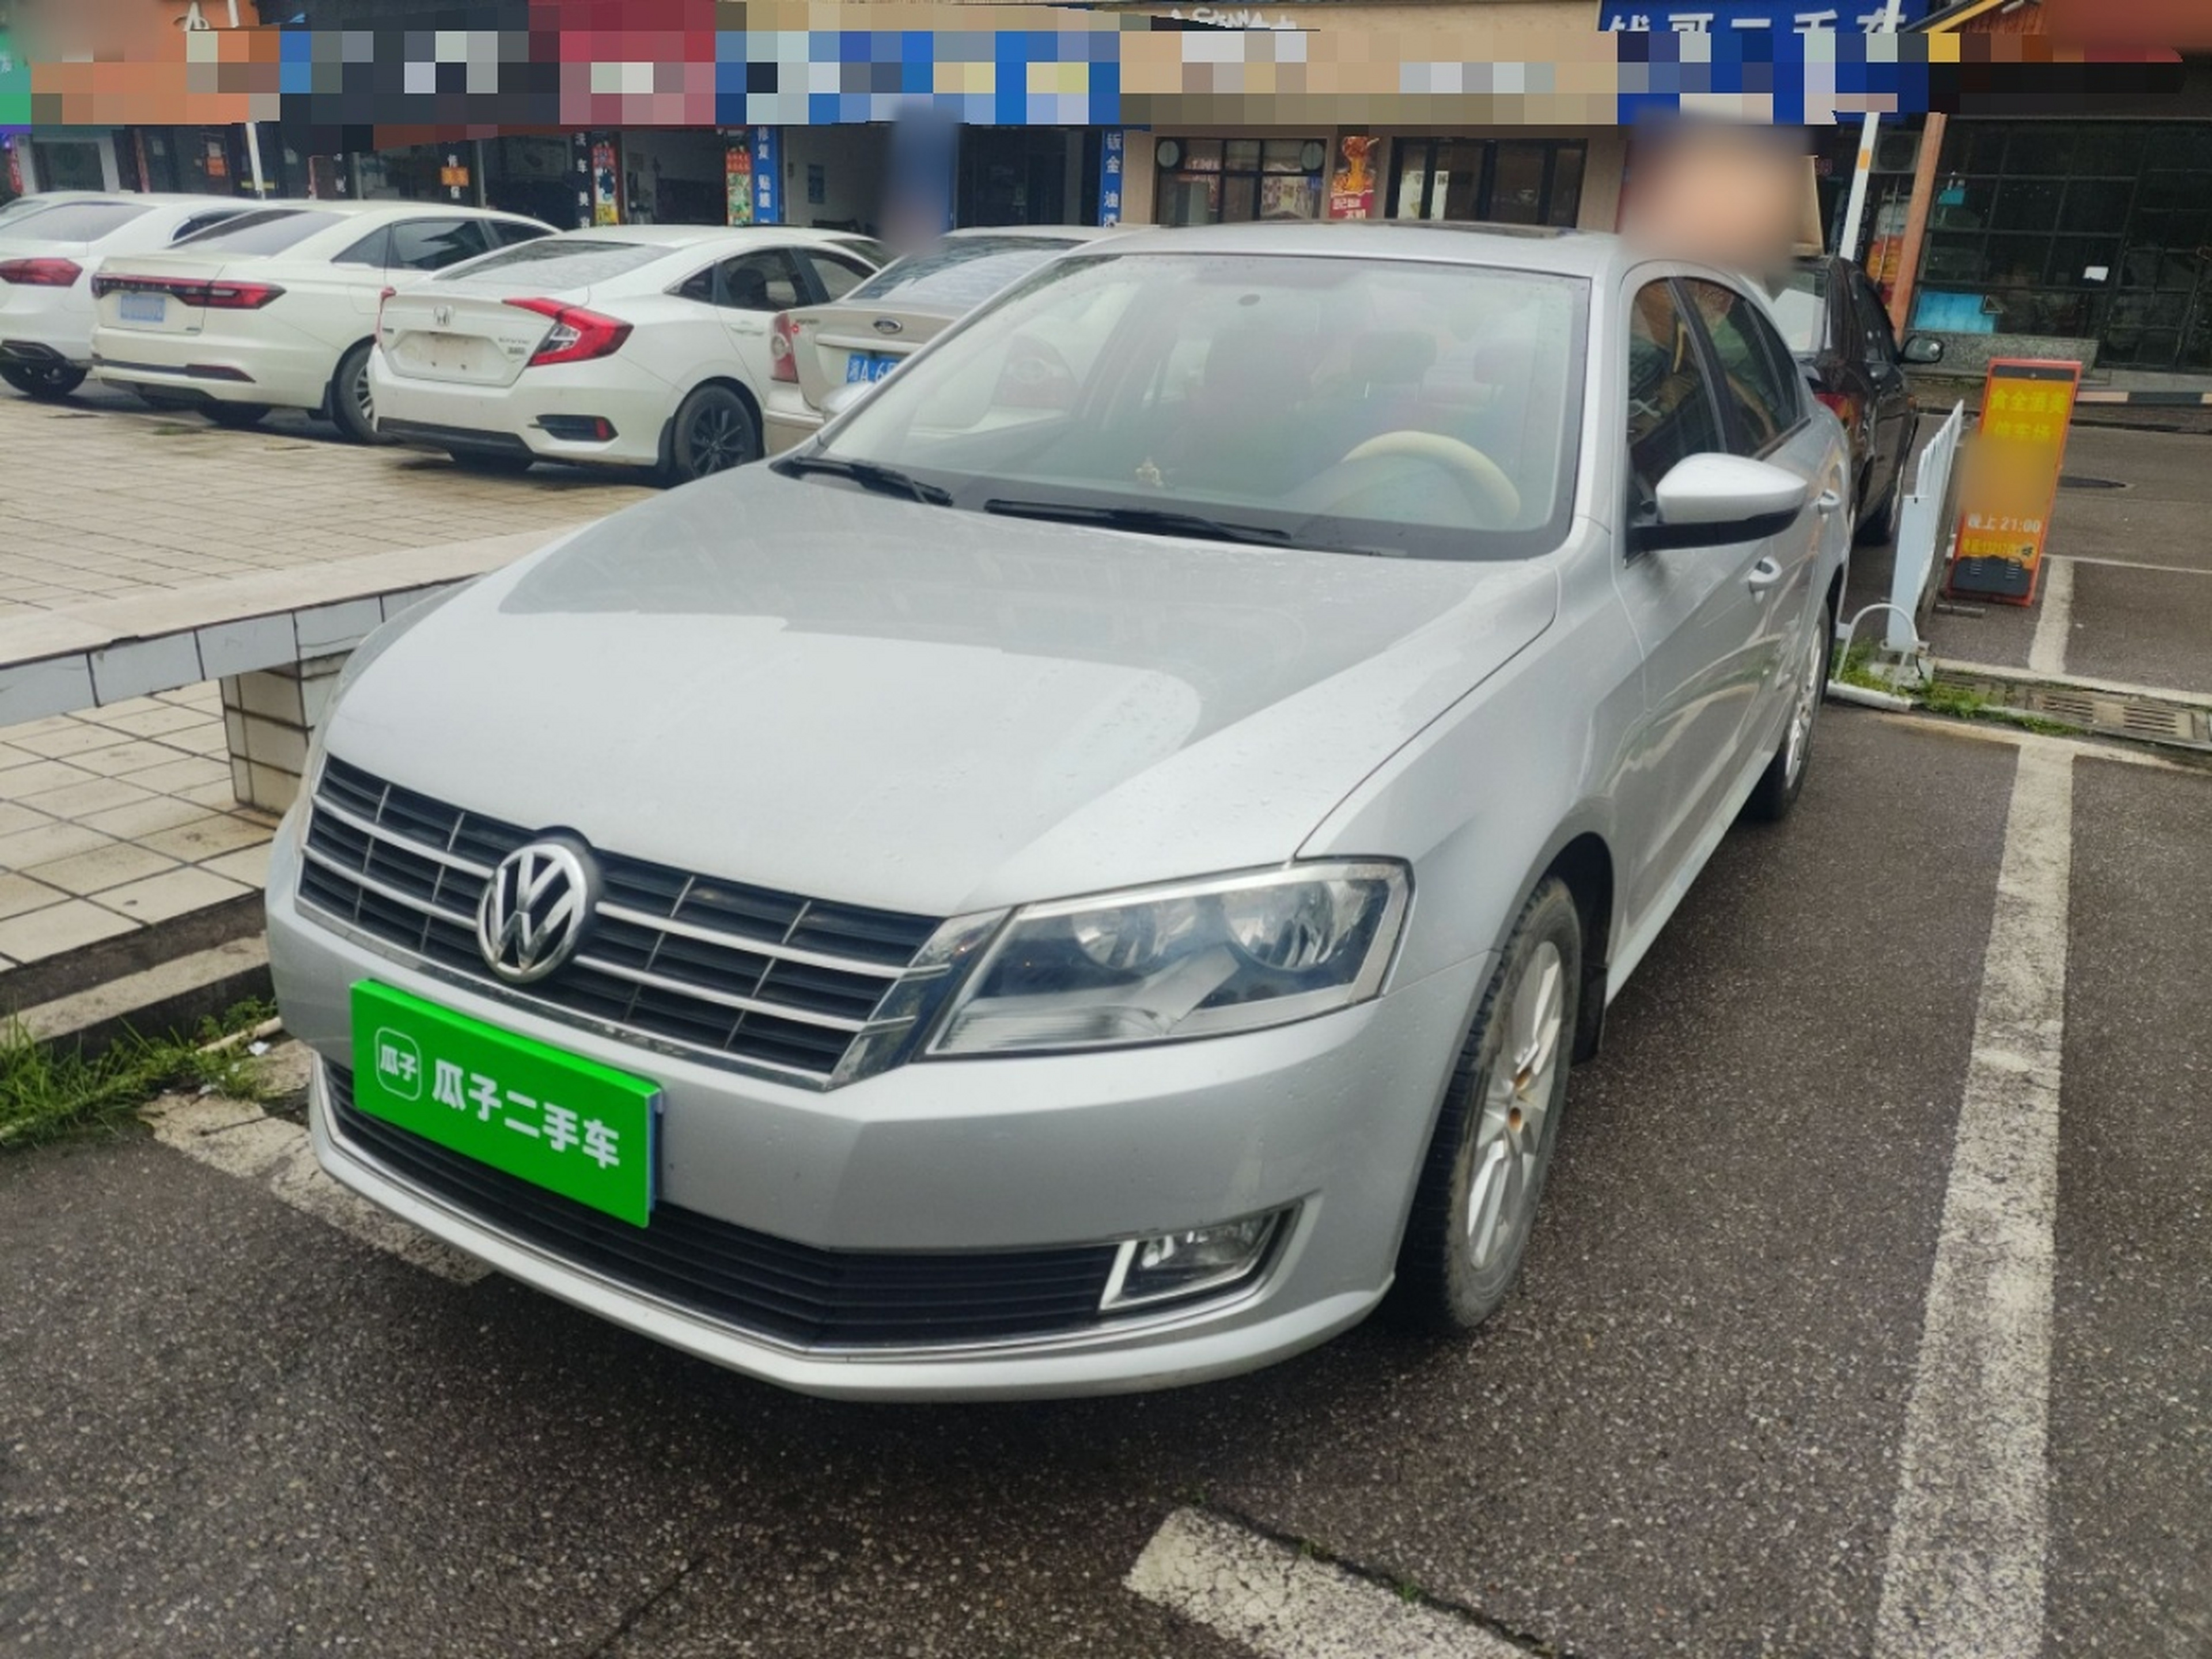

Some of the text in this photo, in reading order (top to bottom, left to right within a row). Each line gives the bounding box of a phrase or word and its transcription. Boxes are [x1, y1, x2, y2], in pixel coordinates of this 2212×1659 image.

[2000, 516, 2041, 534] 21:00
[380, 1044, 620, 1169] 瓜子 瓜子二手车
